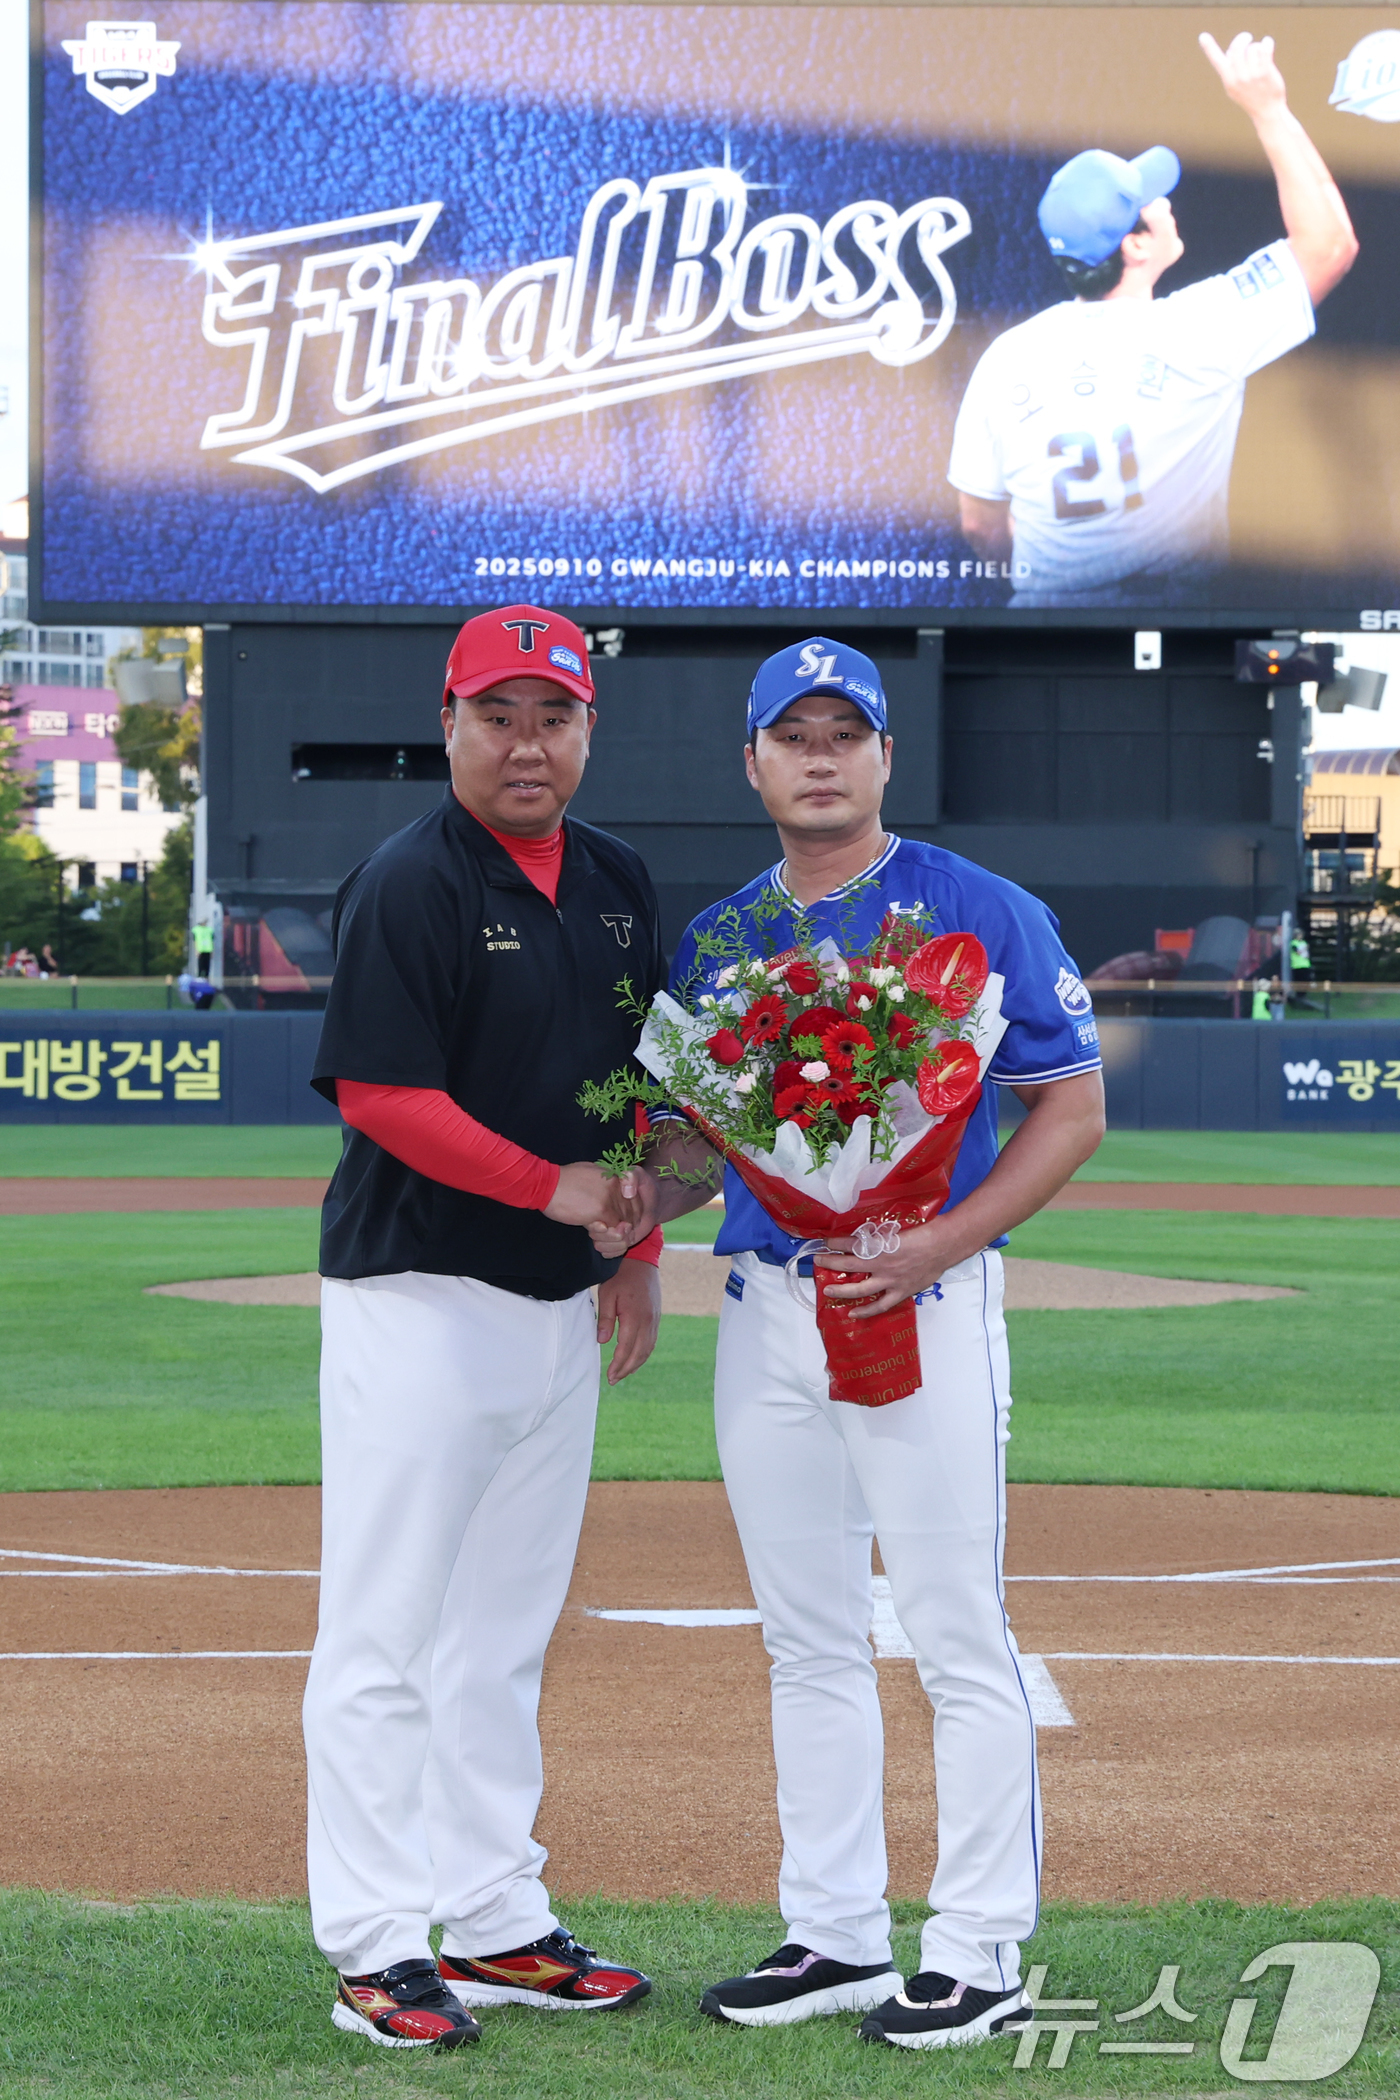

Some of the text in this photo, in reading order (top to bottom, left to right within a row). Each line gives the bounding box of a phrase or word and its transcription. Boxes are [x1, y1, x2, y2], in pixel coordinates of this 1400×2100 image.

[78, 46, 170, 69] TIGERS
[1047, 423, 1144, 520] 21
[474, 557, 1032, 580] 20250910 GWANGJU-KIA CHAMPIONS FIELD
[500, 619, 551, 654] T
[794, 643, 845, 686] SL
[486, 941, 521, 951] STUDIO
[600, 914, 633, 949] T
[0, 1038, 221, 1101] 대방건설
[1286, 1088, 1329, 1101] BANK
